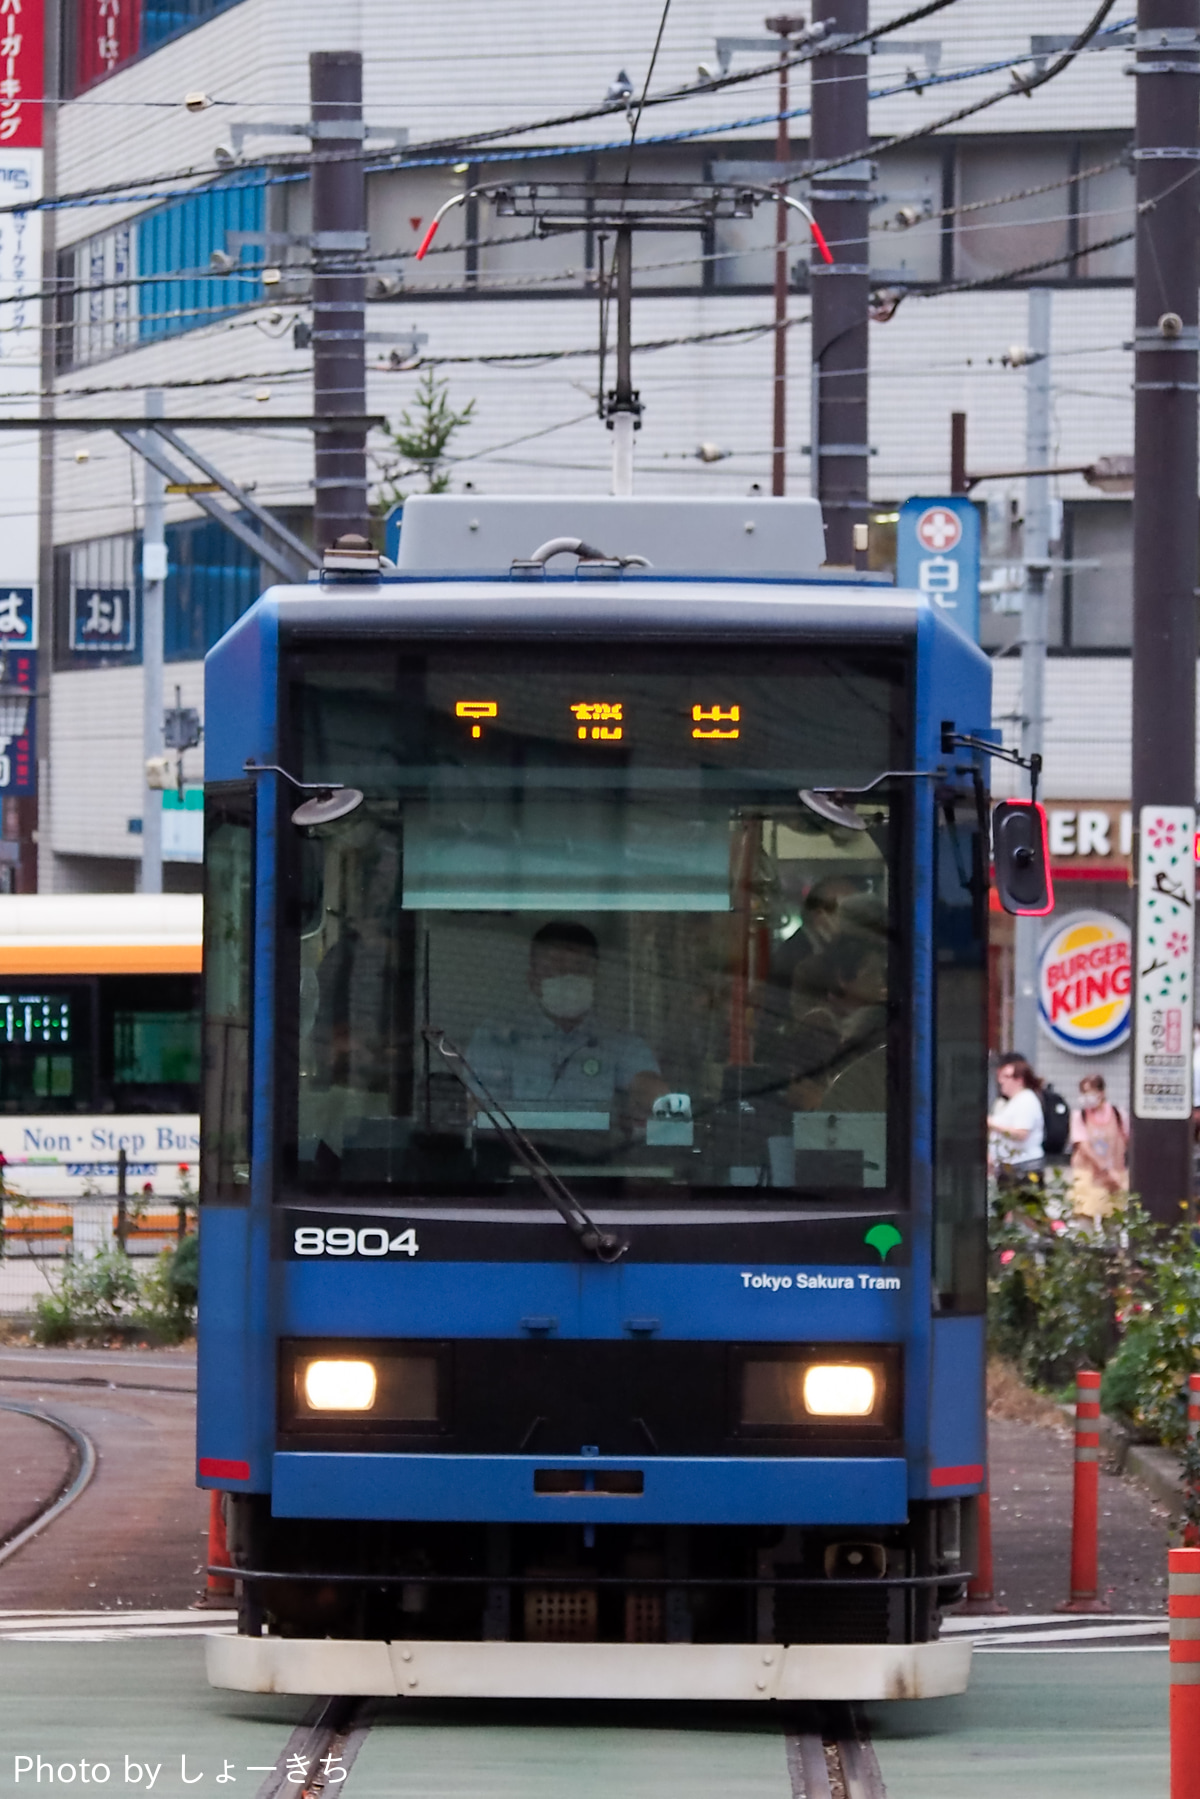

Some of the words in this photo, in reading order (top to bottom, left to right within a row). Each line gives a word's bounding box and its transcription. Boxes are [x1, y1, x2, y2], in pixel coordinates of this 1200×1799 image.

[1047, 942, 1129, 988] BURGER
[1050, 965, 1132, 1024] KING
[156, 1128, 200, 1151] Bus
[293, 1227, 420, 1257] 8904
[741, 1272, 791, 1291] Tokyo
[796, 1272, 854, 1289] Sakura
[857, 1272, 901, 1290] Tram
